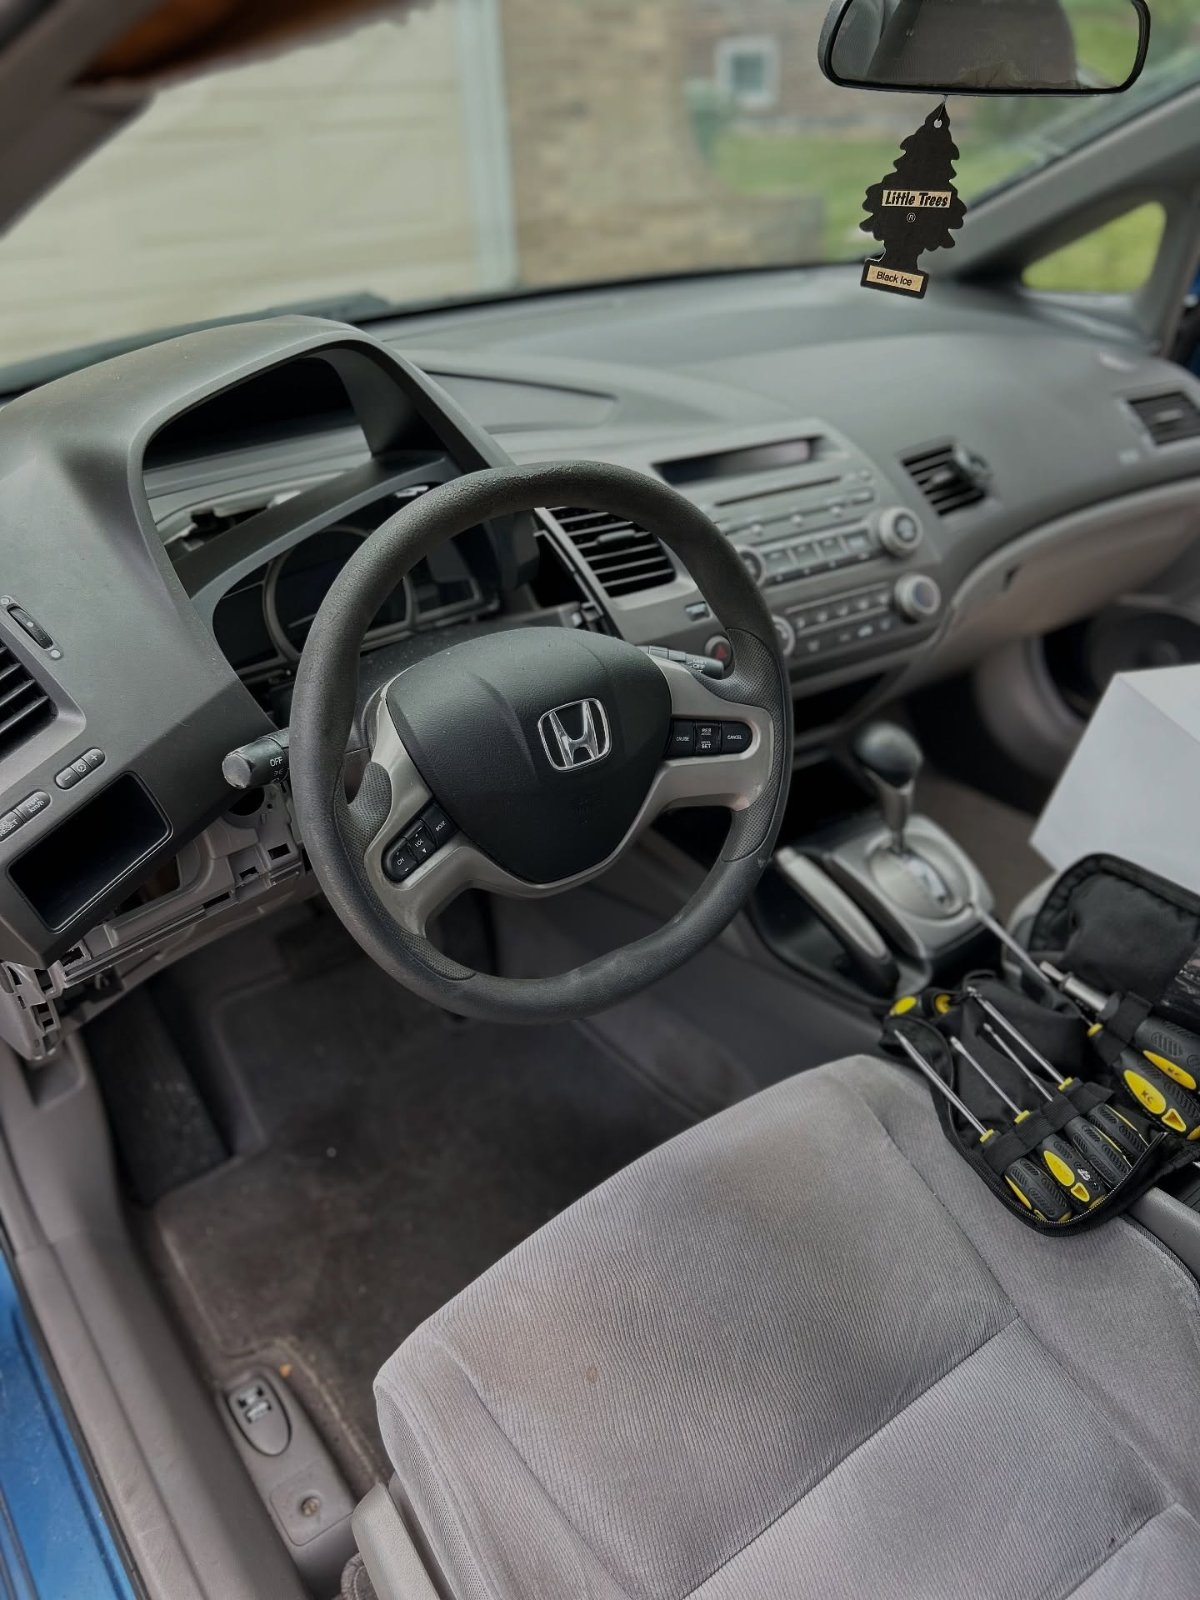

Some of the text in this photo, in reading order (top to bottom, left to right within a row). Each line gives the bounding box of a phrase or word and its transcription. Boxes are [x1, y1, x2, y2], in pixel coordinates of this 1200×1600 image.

[885, 191, 949, 207] Little Trees
[876, 271, 913, 287] Black Ice
[269, 756, 283, 767] OFF
[396, 857, 405, 866] CH
